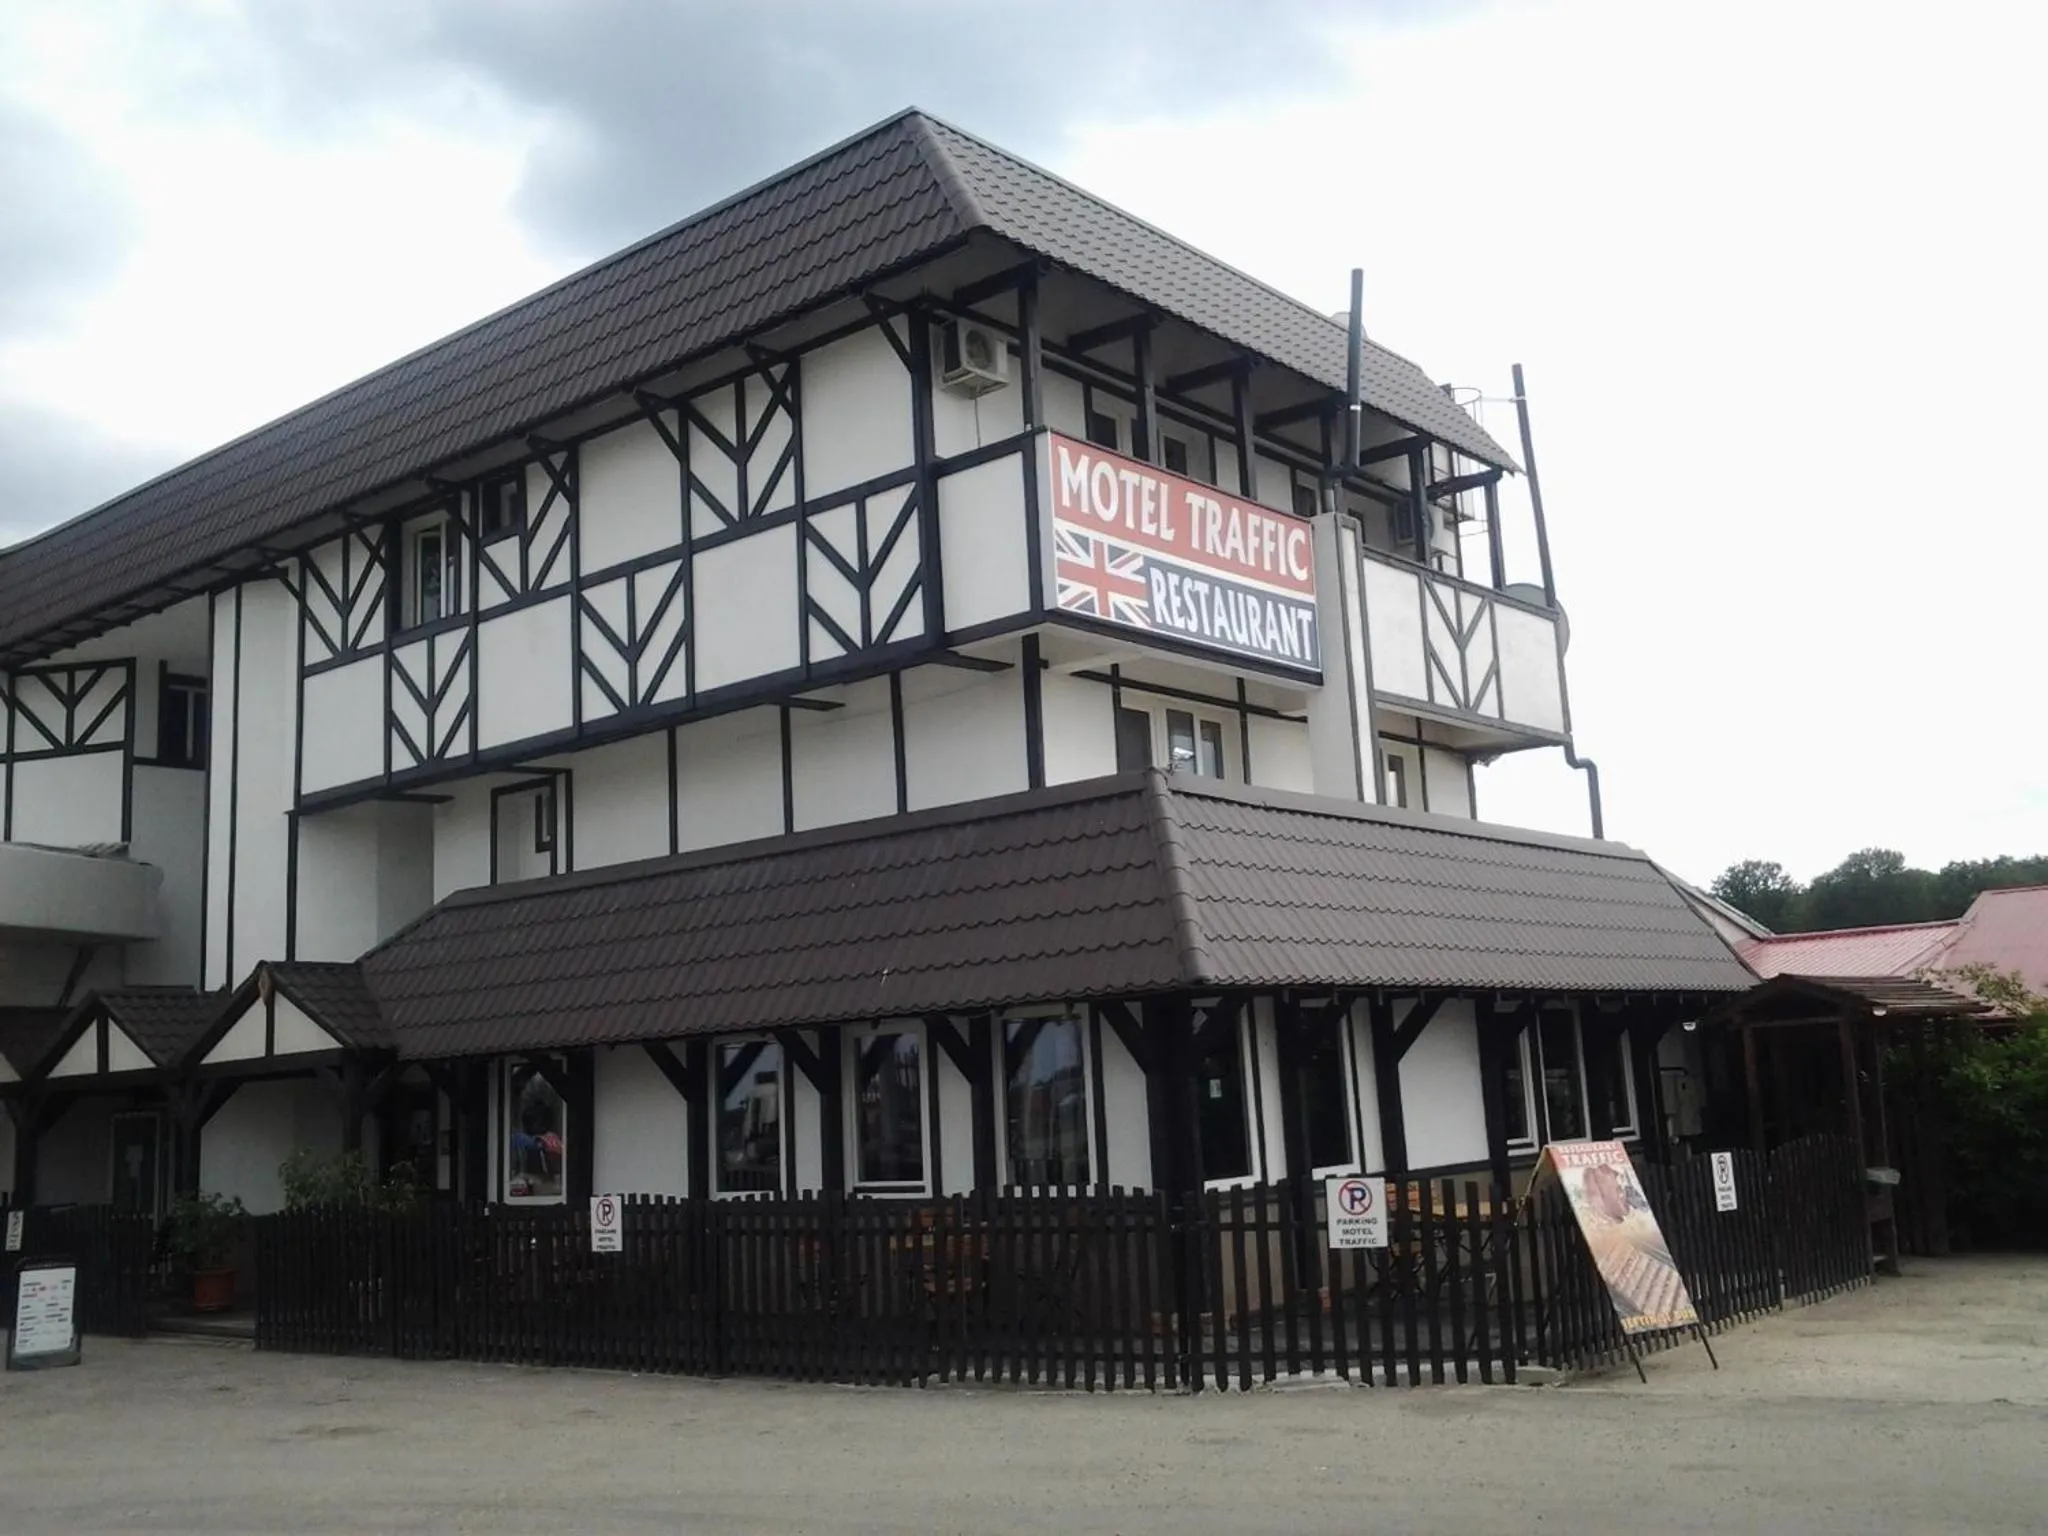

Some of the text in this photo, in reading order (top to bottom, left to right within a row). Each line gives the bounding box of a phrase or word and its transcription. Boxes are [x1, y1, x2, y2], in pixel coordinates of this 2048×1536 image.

[1057, 446, 1310, 582] MOTEL TRAFFIC
[1150, 567, 1313, 660] RESTAURANT
[1560, 1150, 1625, 1167] TRAFFIC
[1342, 1228, 1374, 1236] MOTEL
[1339, 1238, 1378, 1246] TRAFFIC
